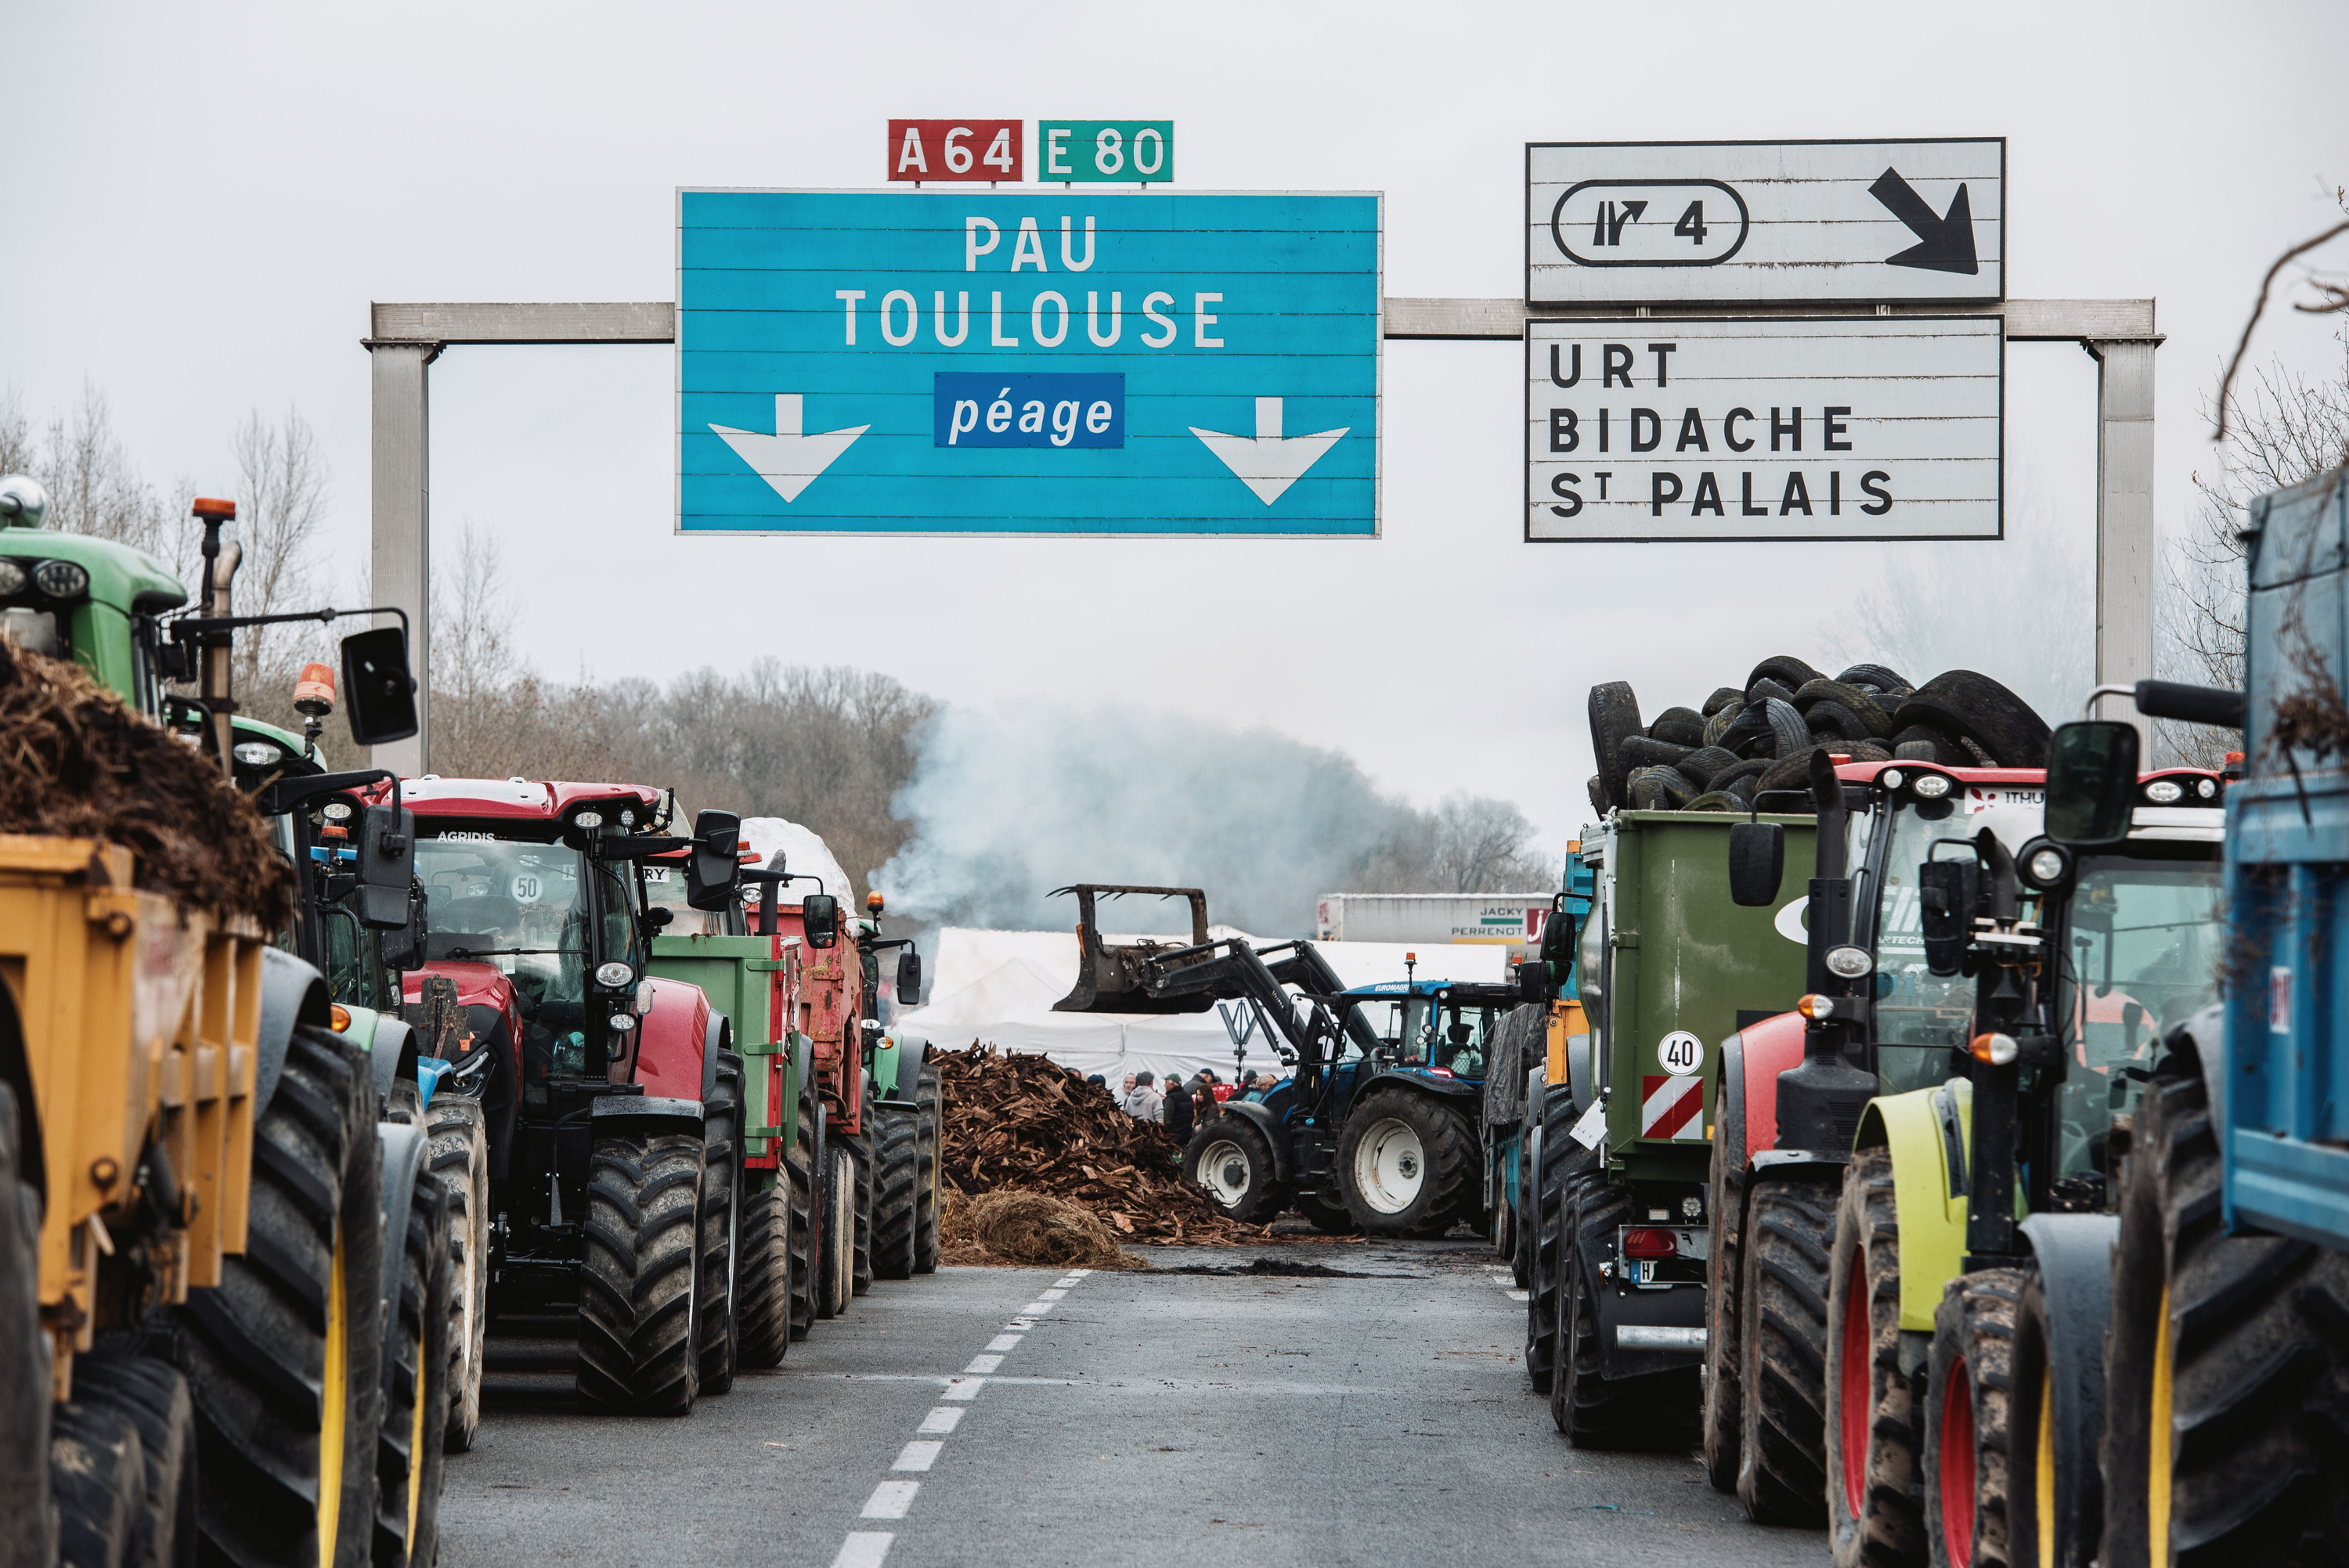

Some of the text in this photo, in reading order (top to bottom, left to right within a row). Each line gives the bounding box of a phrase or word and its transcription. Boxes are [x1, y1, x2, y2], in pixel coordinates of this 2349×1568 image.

[897, 127, 1014, 174] A 64
[1048, 128, 1164, 175] E 80
[965, 216, 1096, 272] PAU
[1674, 200, 1708, 245] 4
[835, 290, 1225, 349] TOULOUSE
[1550, 343, 1676, 388] URT
[949, 387, 1113, 446] péage
[1550, 406, 1853, 452] BIDACHE
[1651, 470, 1893, 517] PALAIS
[436, 831, 495, 845] AGRIDIS
[518, 878, 537, 898] 50
[1452, 927, 1523, 935] PERRENOT
[1374, 983, 1409, 992] EUROMAGRI
[1667, 1040, 1694, 1067] 40
